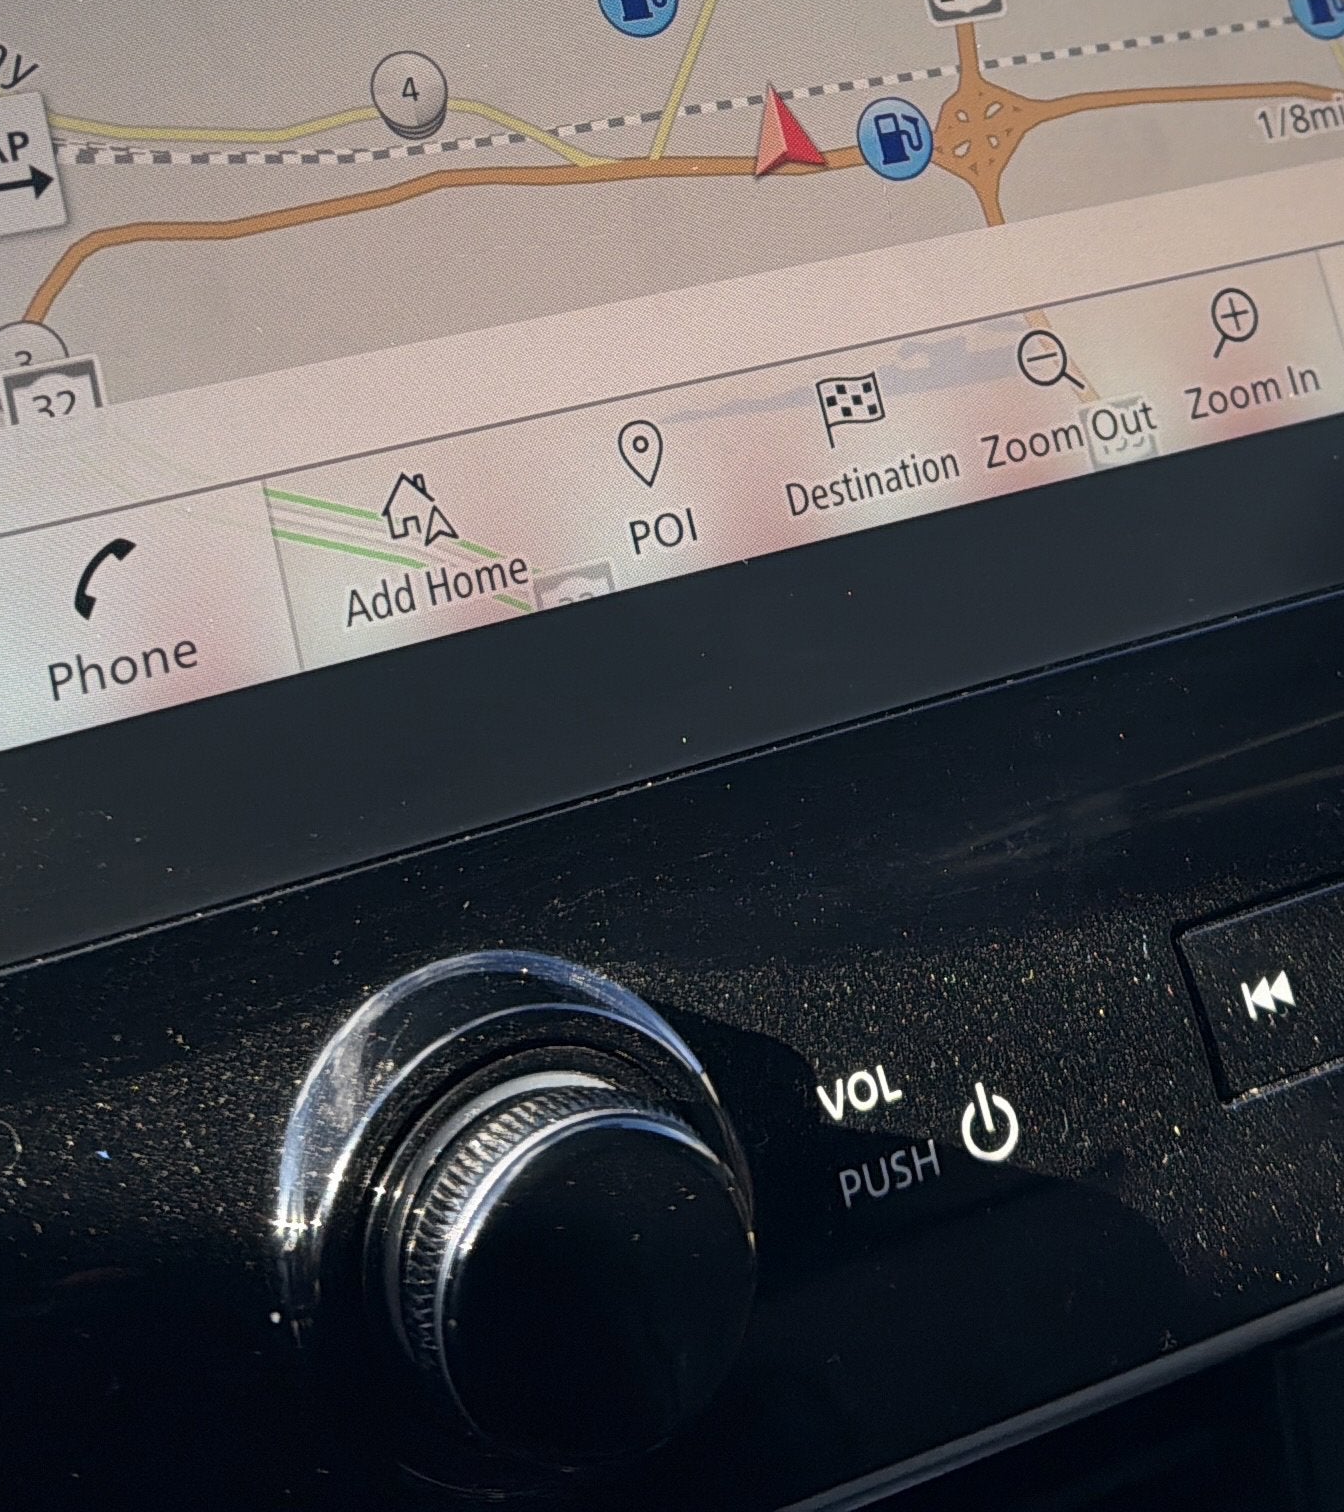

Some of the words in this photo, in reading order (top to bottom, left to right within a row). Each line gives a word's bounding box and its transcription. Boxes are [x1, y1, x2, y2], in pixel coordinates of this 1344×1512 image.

[401, 76, 421, 103] 4
[1184, 376, 1282, 420] Zoom
[1287, 364, 1321, 396] In
[981, 419, 1086, 469] Zoom
[1092, 401, 1157, 441] Out
[786, 451, 960, 517] Destination
[628, 507, 699, 555] POI
[346, 574, 417, 627] Add
[425, 555, 530, 607] Home
[47, 638, 200, 702] Phone
[816, 1064, 903, 1121] VOL
[839, 1138, 941, 1209] PUSH
